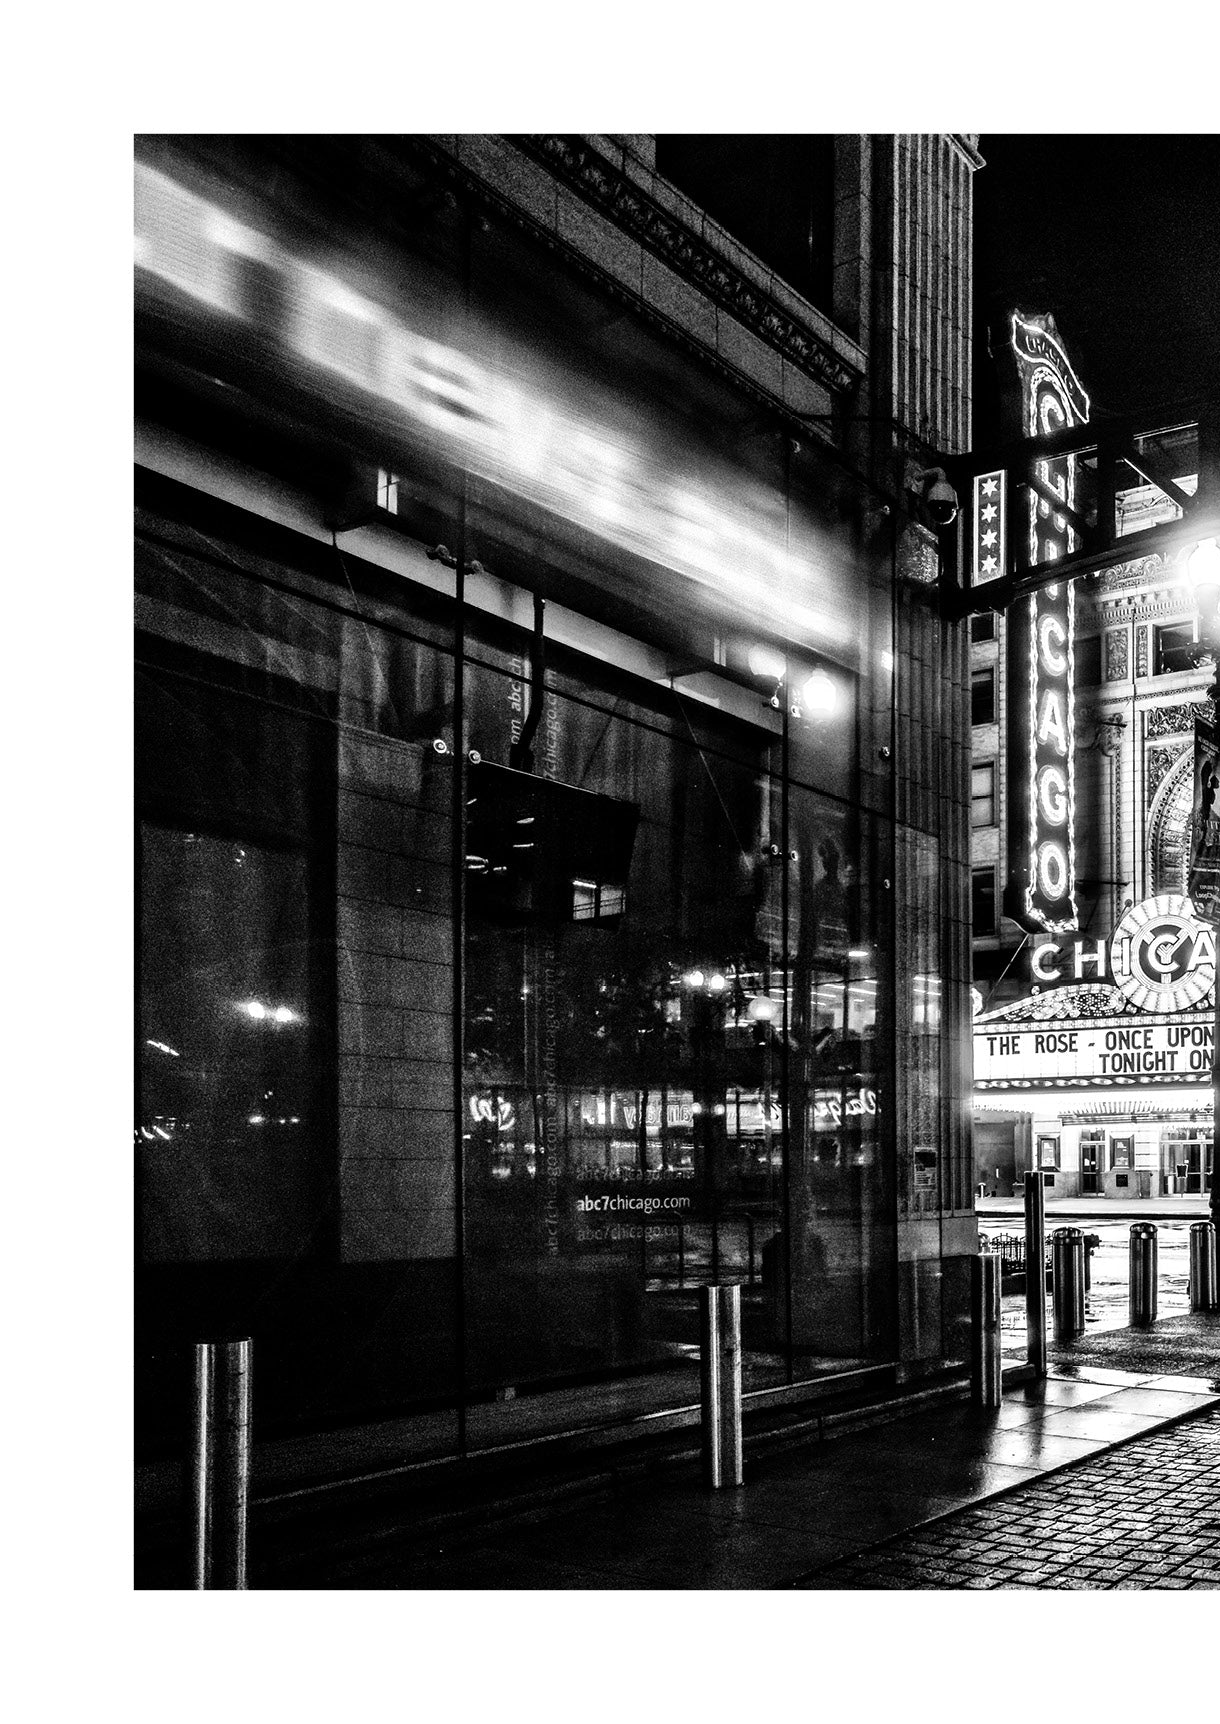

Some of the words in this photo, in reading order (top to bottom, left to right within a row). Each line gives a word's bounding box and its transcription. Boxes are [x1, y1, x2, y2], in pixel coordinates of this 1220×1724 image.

[987, 1035, 1021, 1056] THE
[1035, 1033, 1079, 1054] ROSE
[1105, 1029, 1154, 1051] ONCE
[1167, 1026, 1215, 1048] UPON
[1099, 1050, 1179, 1074] TONIGHT
[576, 1193, 691, 1215] abc7chicago.com
